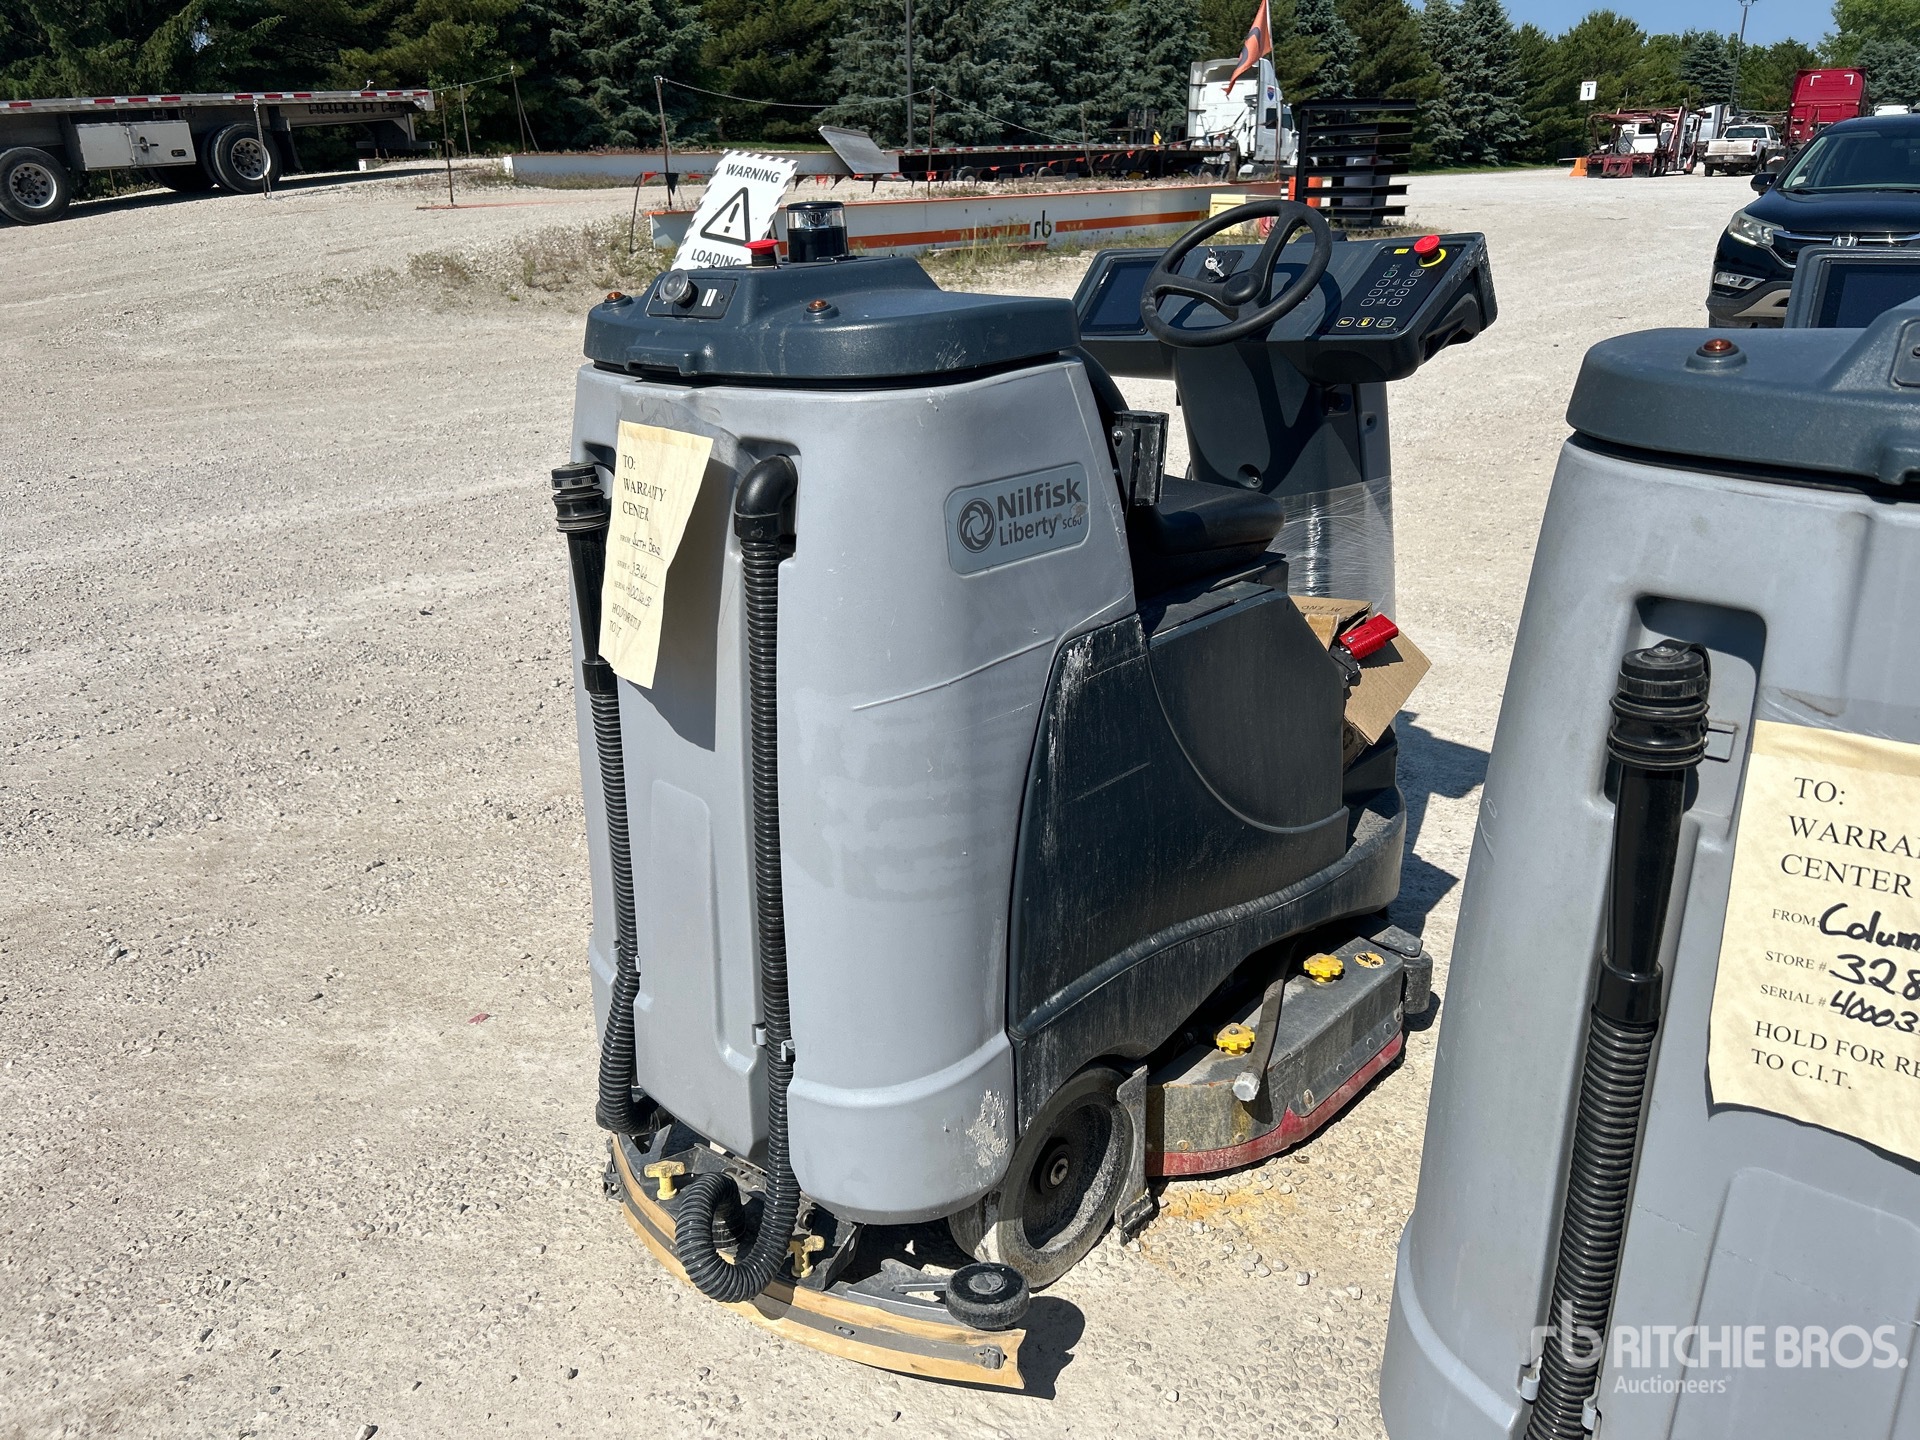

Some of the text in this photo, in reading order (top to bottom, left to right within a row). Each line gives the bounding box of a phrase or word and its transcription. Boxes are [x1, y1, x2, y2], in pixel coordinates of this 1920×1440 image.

[726, 163, 781, 184] WARNING
[1034, 210, 1052, 239] rb
[623, 454, 636, 470] TO:
[997, 478, 1082, 522] Nilfisk
[1000, 515, 1058, 547] Liberty
[1794, 776, 1846, 806] TO:
[1788, 814, 1920, 860] WARRA
[1780, 853, 1914, 898] CENTER
[1765, 950, 1815, 970] STORE
[1818, 962, 1827, 972] #
[1760, 984, 1920, 1034] SERIAL # 40003
[1755, 1020, 1828, 1051] HOLD
[1835, 1038, 1886, 1069] FOR
[1751, 1048, 1852, 1090] TO C.I.T.
